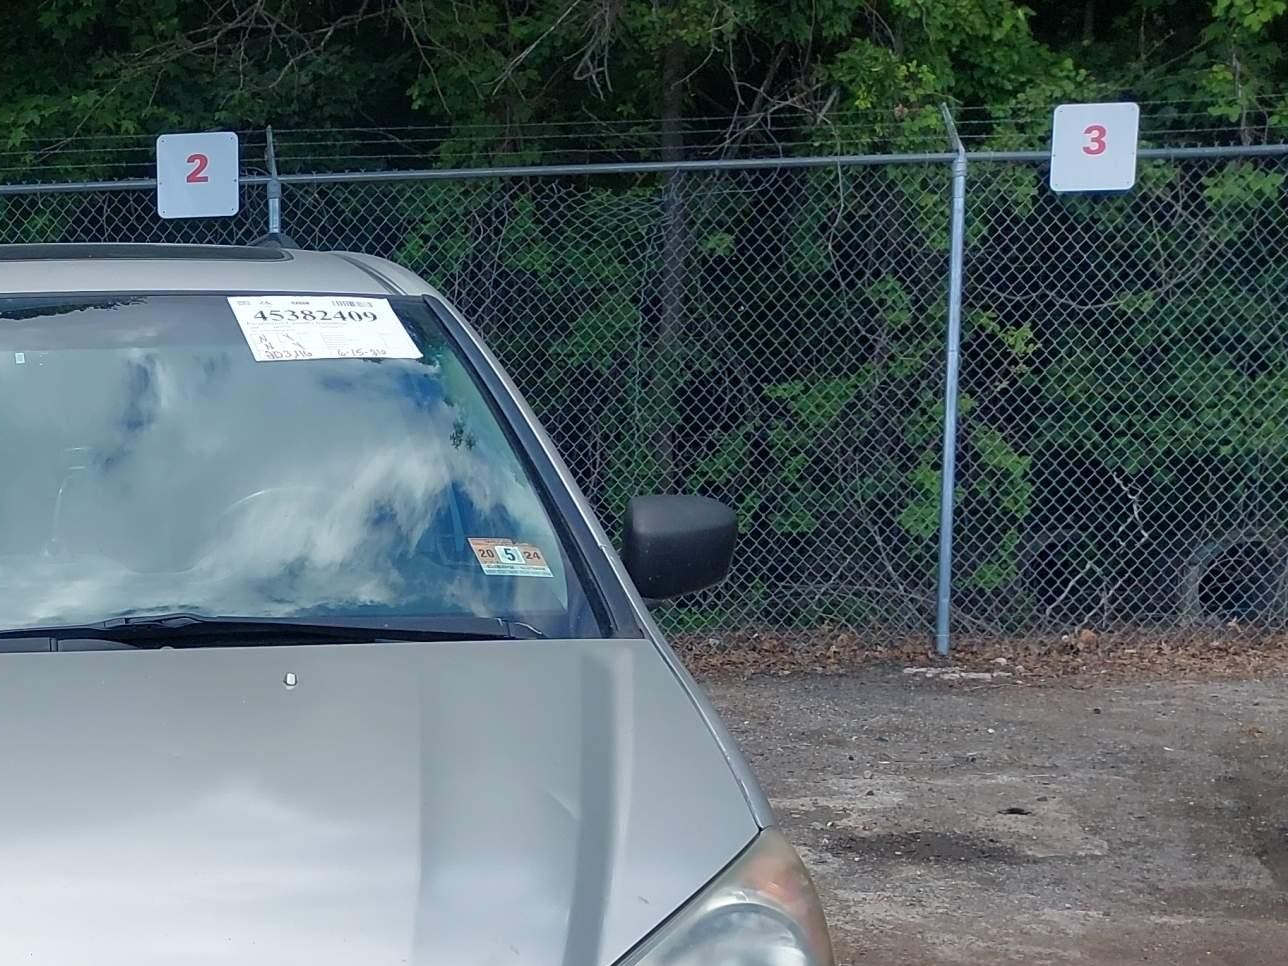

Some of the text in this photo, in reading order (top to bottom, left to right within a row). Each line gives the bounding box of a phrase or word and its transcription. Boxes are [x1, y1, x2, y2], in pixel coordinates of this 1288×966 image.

[1082, 125, 1106, 155] 3
[187, 153, 209, 183] 2
[253, 309, 378, 322] 45382409
[478, 548, 541, 561] 20 5 24
